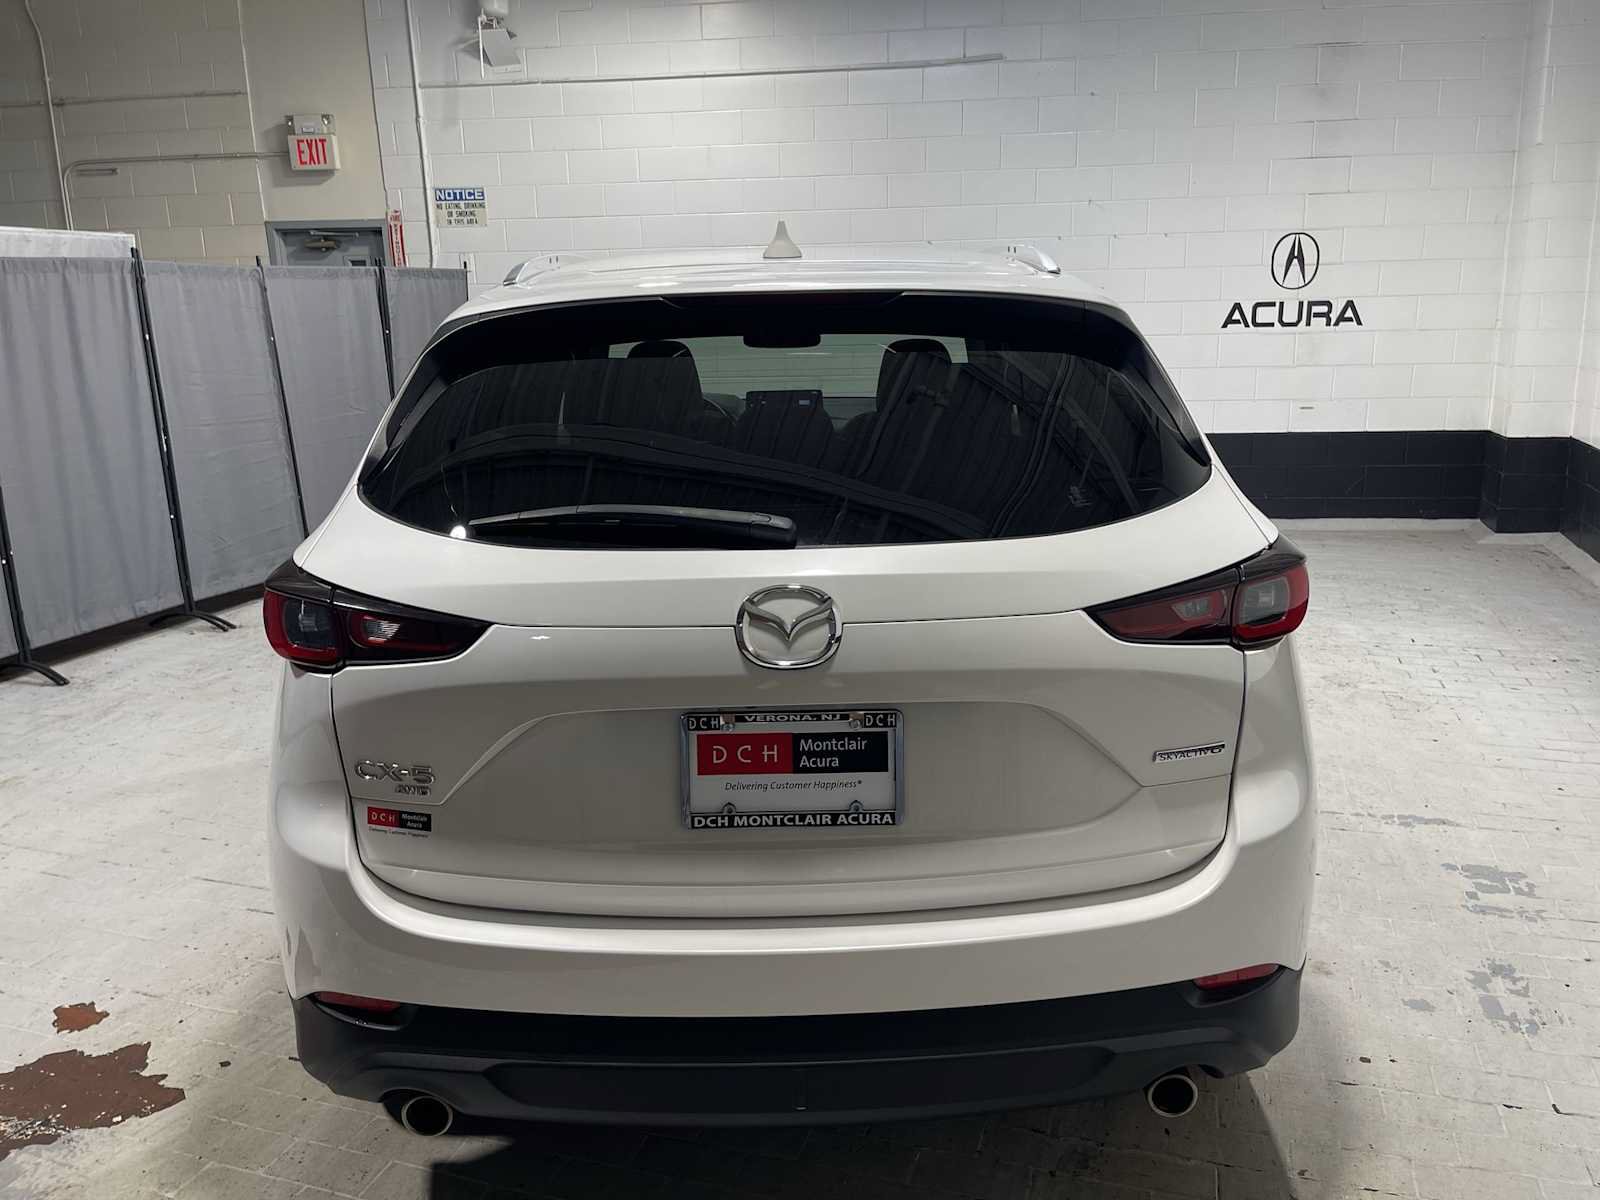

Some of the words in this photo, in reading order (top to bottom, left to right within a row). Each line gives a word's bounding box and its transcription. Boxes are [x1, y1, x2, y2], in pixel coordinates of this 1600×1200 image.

[296, 138, 327, 165] EXIT
[436, 189, 484, 200] NOTICE
[1221, 300, 1363, 328] ACURA
[821, 713, 841, 721] NJ
[799, 737, 867, 752] Montclair
[799, 755, 840, 768] Acura
[355, 760, 436, 785] CX-5
[724, 781, 768, 792] Delivering
[770, 780, 812, 791] Customer
[401, 813, 428, 822] Montclair
[693, 816, 729, 828] DCH
[733, 814, 832, 827] MONTCLAIR
[836, 813, 893, 825] ACURA
[406, 820, 423, 829] Acura
